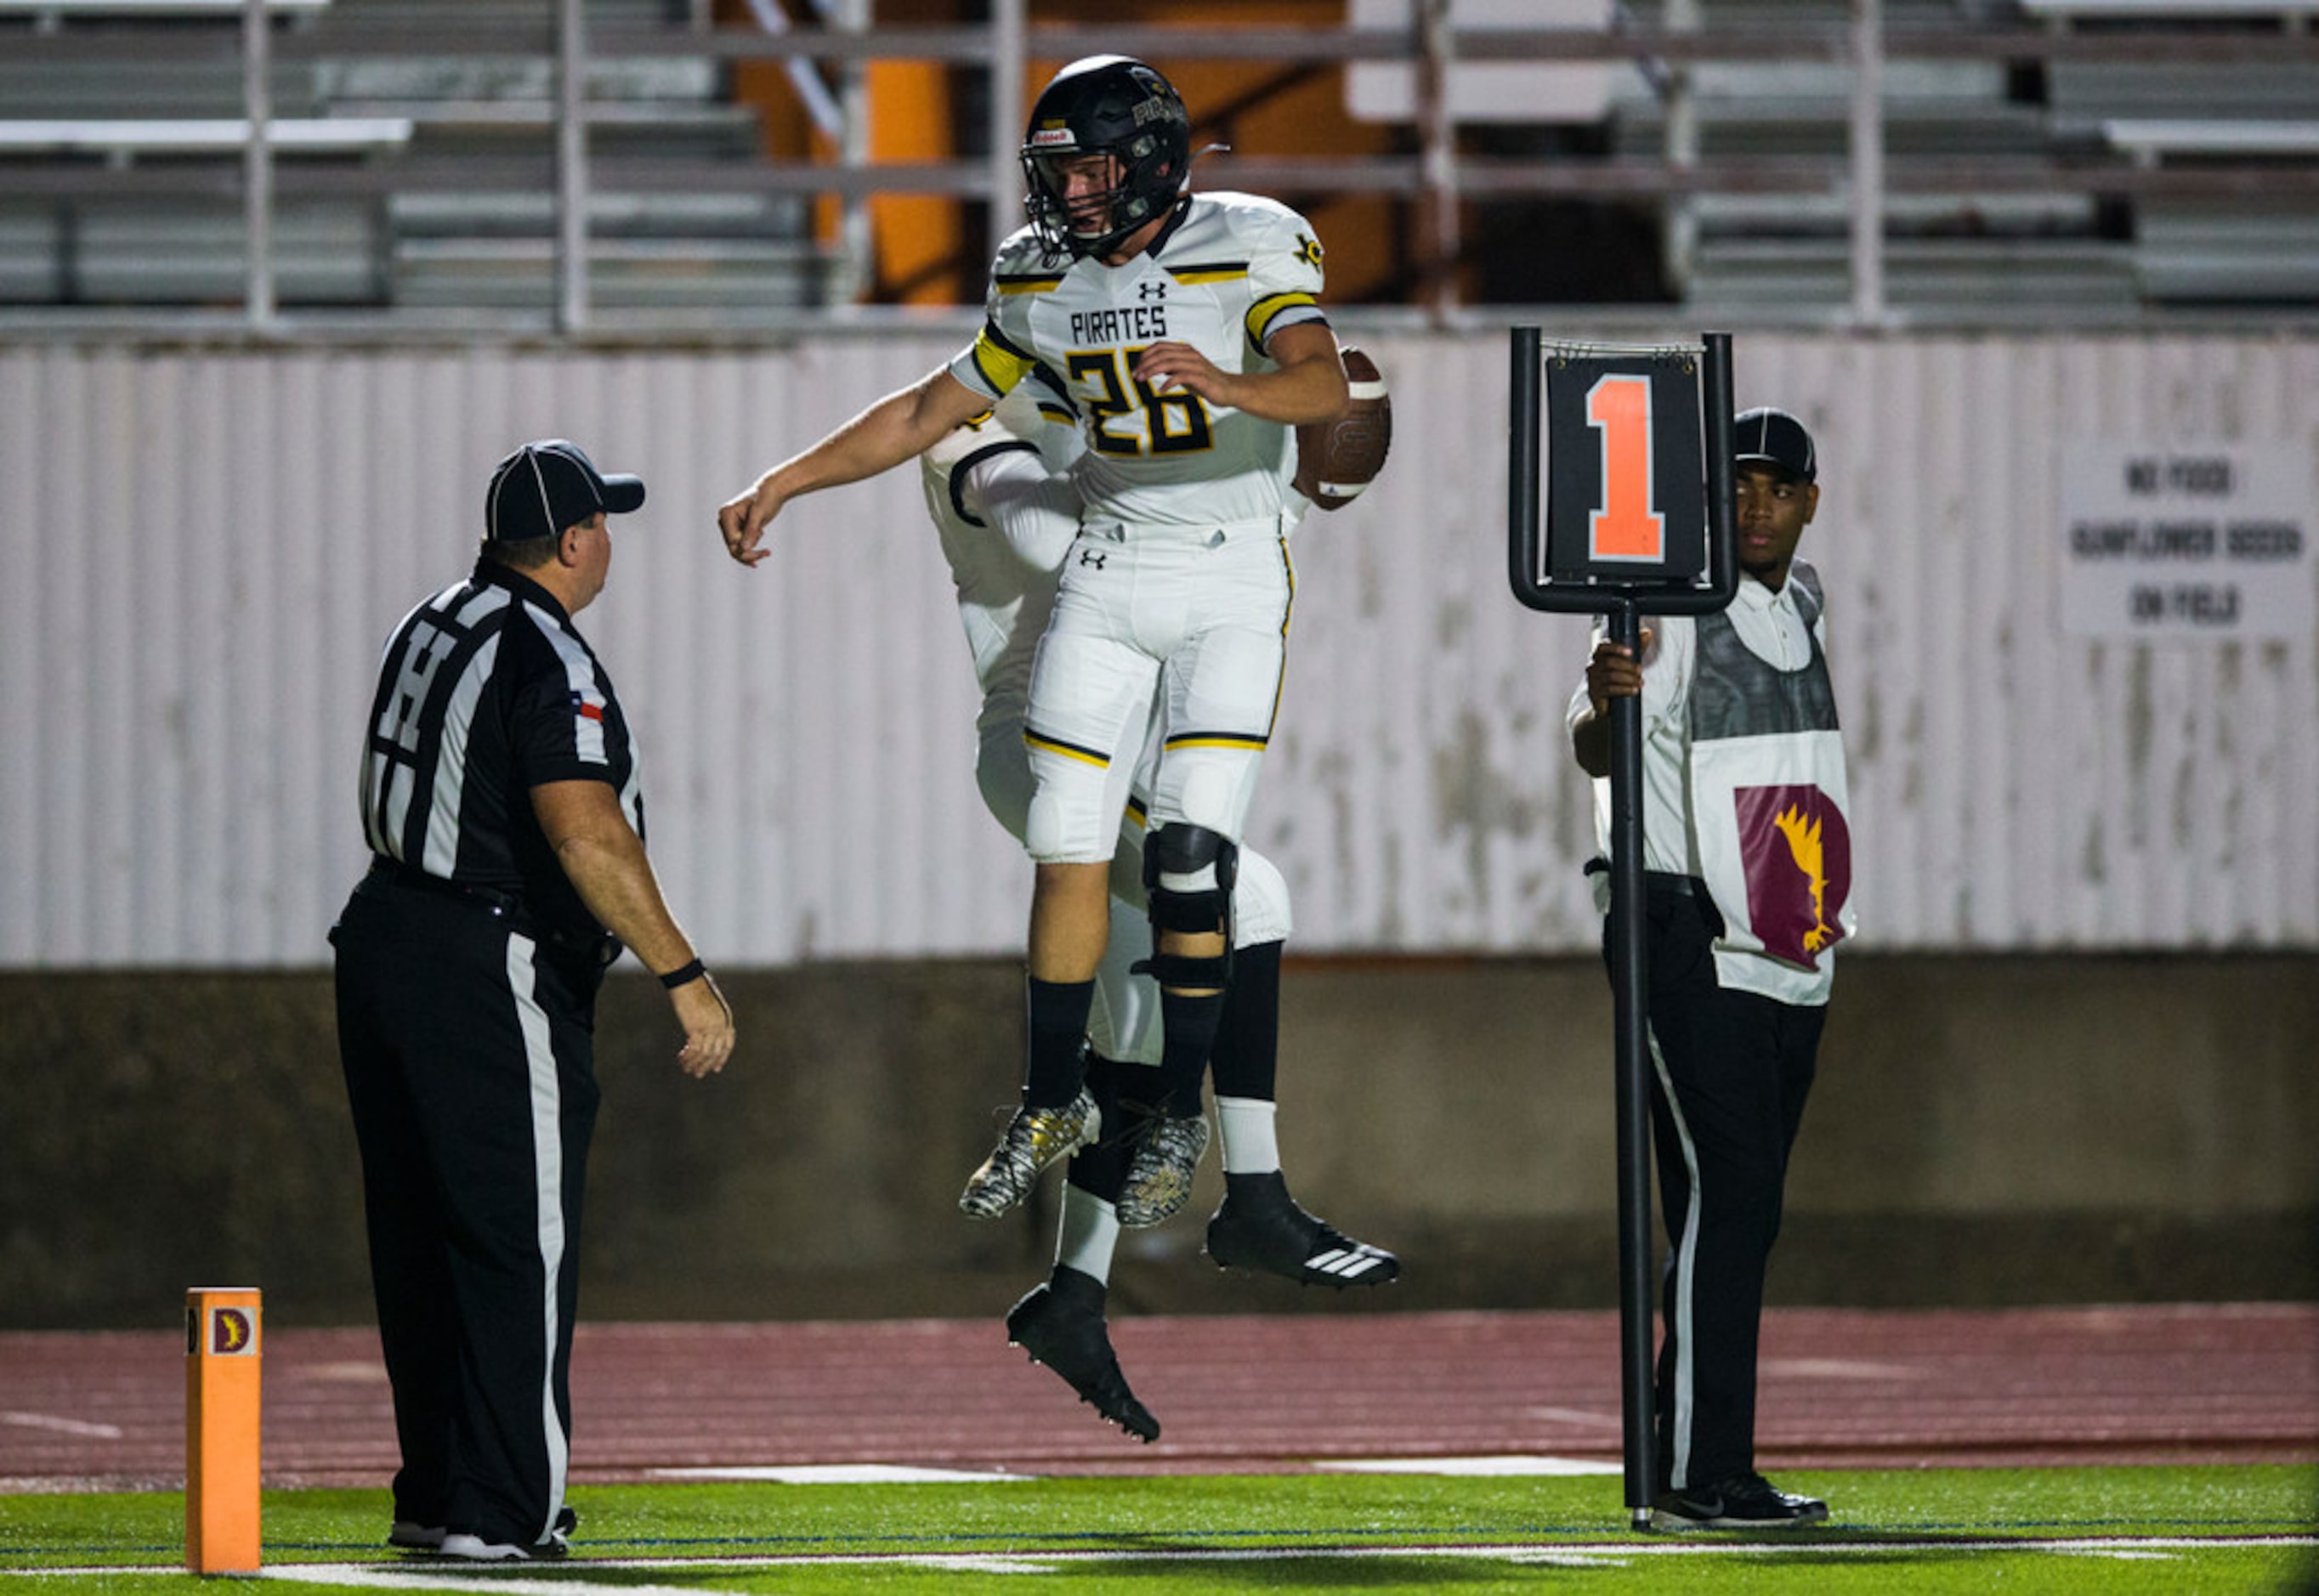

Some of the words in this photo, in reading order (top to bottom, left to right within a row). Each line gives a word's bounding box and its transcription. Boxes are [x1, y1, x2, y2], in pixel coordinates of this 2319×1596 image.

[1070, 305, 1168, 345] PIRATES
[1064, 342, 1214, 457] 26
[1585, 372, 1665, 563] 1
[377, 619, 458, 754] H
